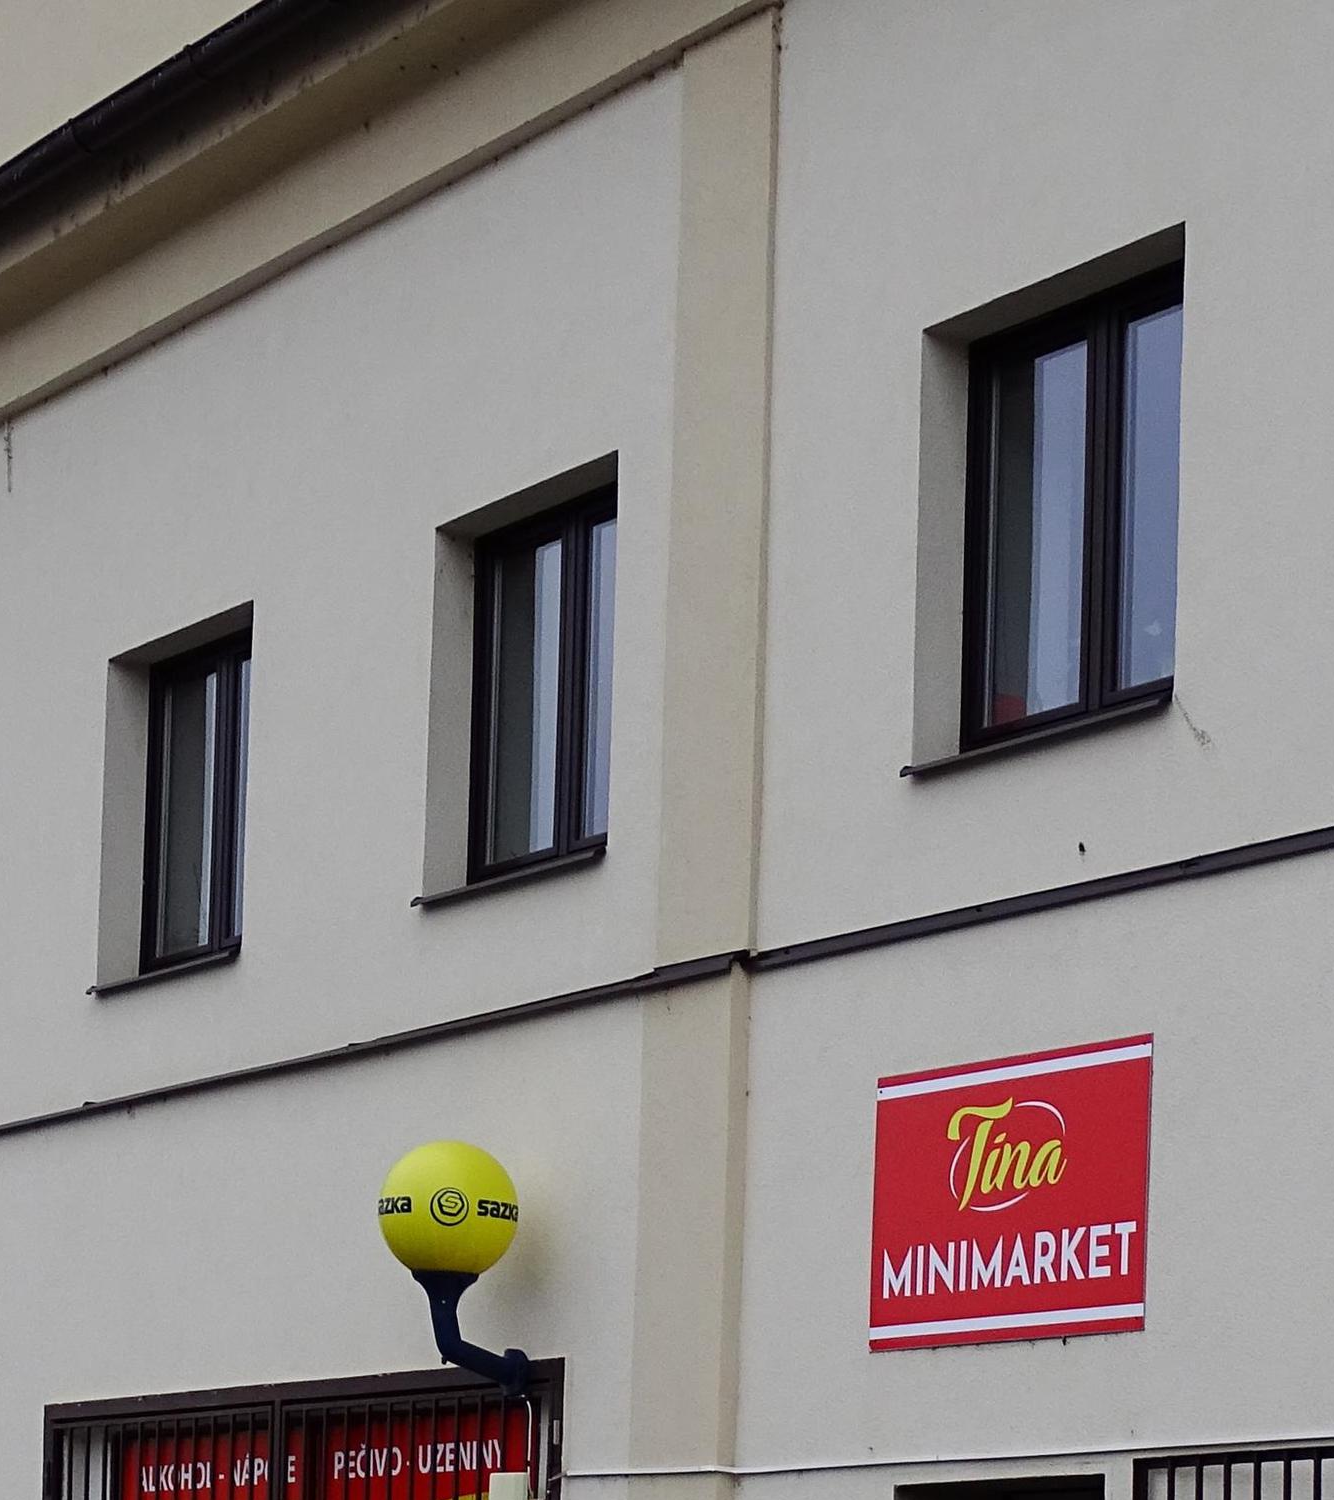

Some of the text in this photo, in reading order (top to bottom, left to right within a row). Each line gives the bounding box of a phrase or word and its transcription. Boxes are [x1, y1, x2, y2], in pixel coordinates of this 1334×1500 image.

[946, 1096, 1067, 1212] Tina
[379, 1196, 412, 1216] azka
[882, 1220, 1137, 1300] MINIMARKET
